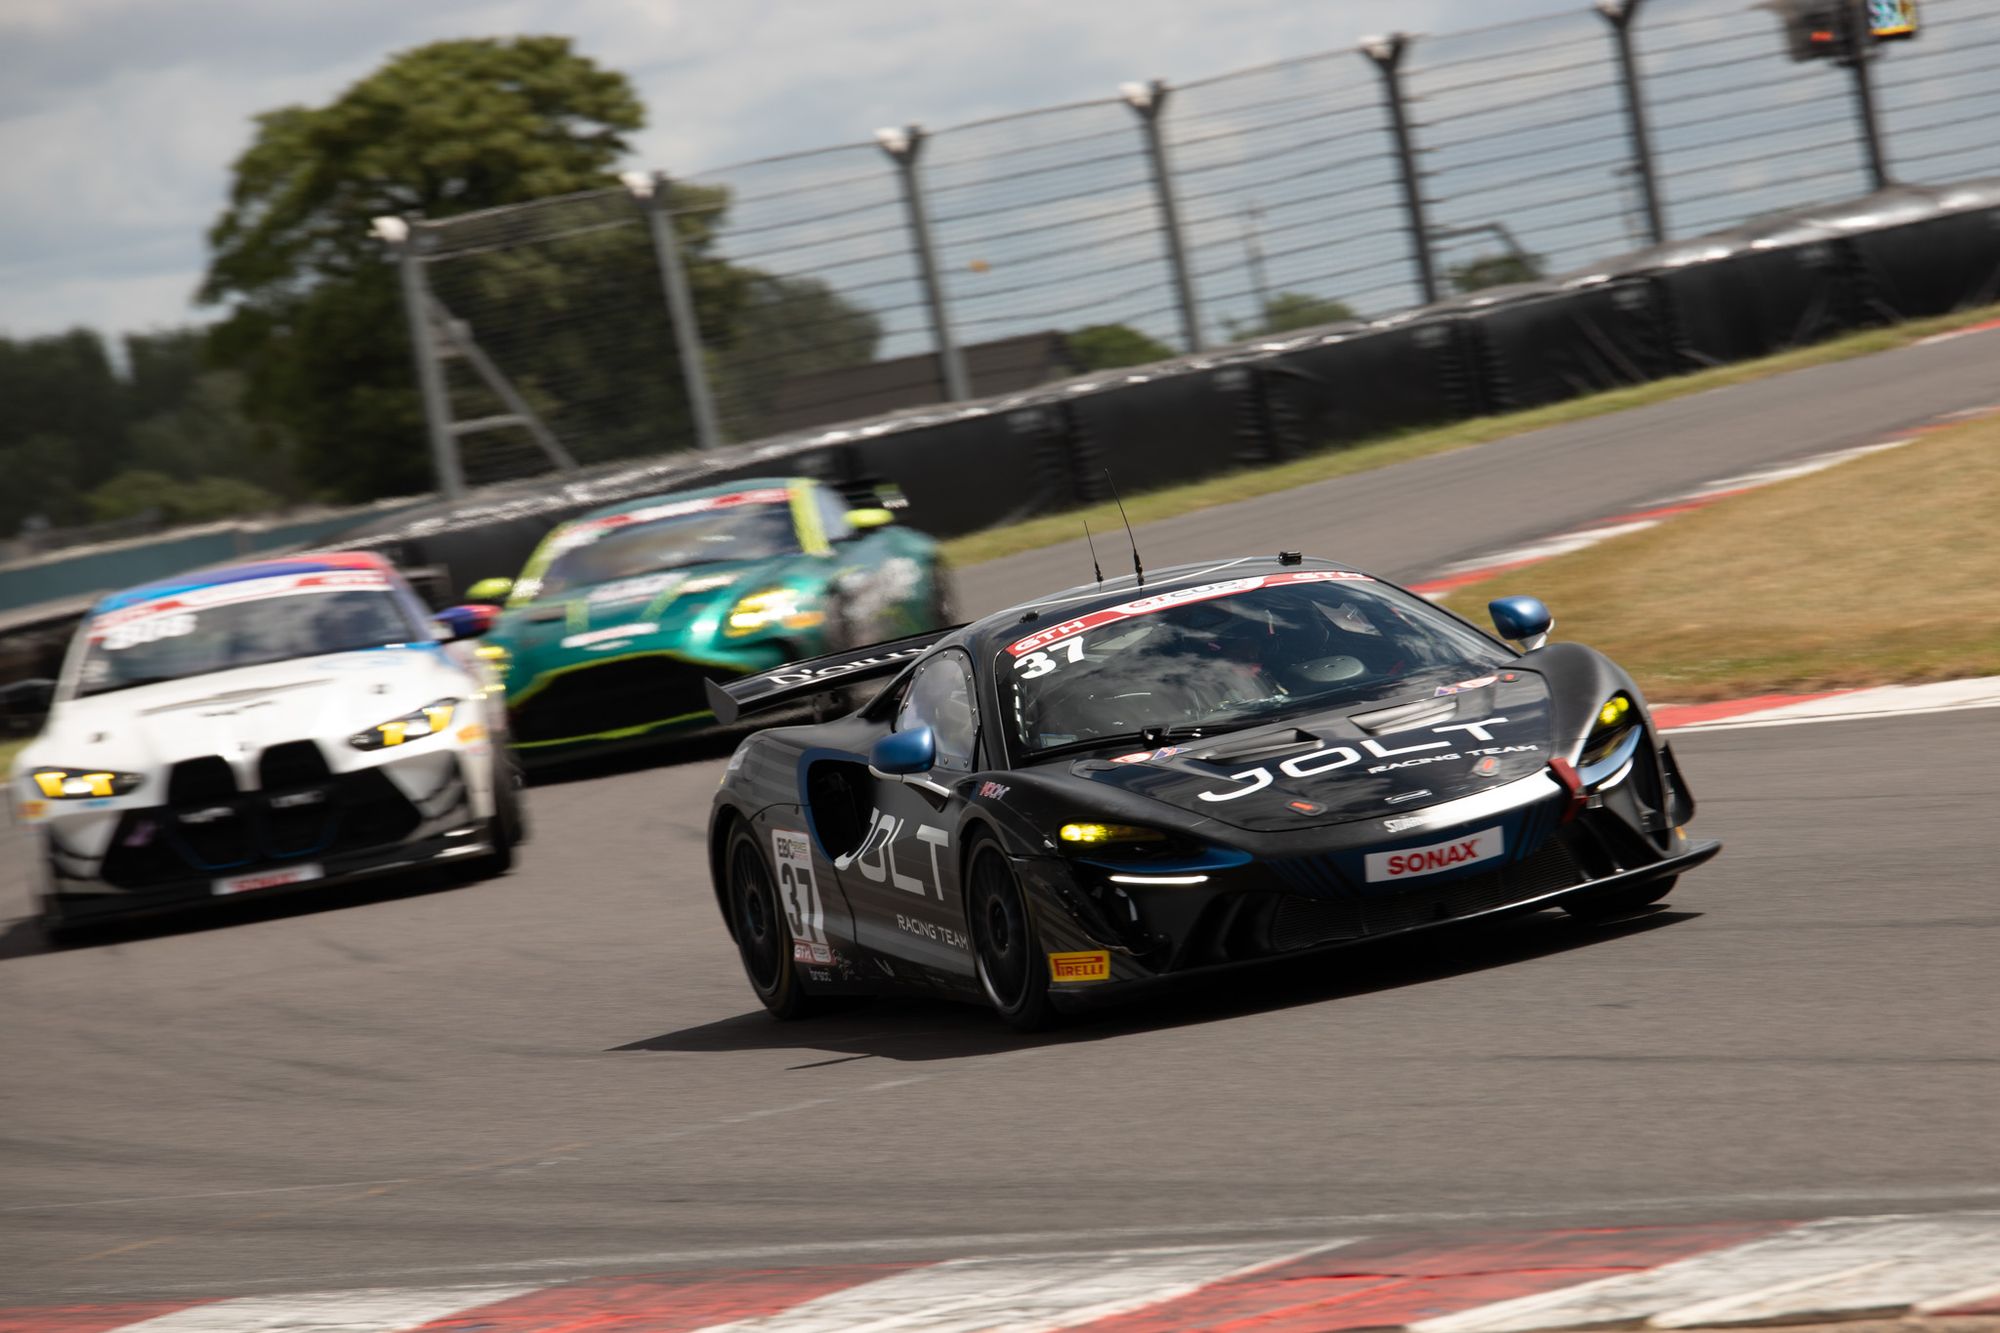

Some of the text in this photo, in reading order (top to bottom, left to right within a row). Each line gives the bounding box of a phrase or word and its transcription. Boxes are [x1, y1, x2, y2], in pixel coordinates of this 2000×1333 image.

[1014, 621, 1086, 651] GTH
[1013, 635, 1085, 679] 37
[1198, 717, 1509, 802] JOLT
[1367, 745, 1538, 774] RACING TEAM
[776, 837, 795, 859] EBC
[834, 807, 949, 900] JOLT
[1388, 839, 1480, 875] SONAX
[781, 862, 818, 943] 37
[896, 914, 968, 950] RACING TEAM
[1053, 956, 1104, 977] PIRELLI
